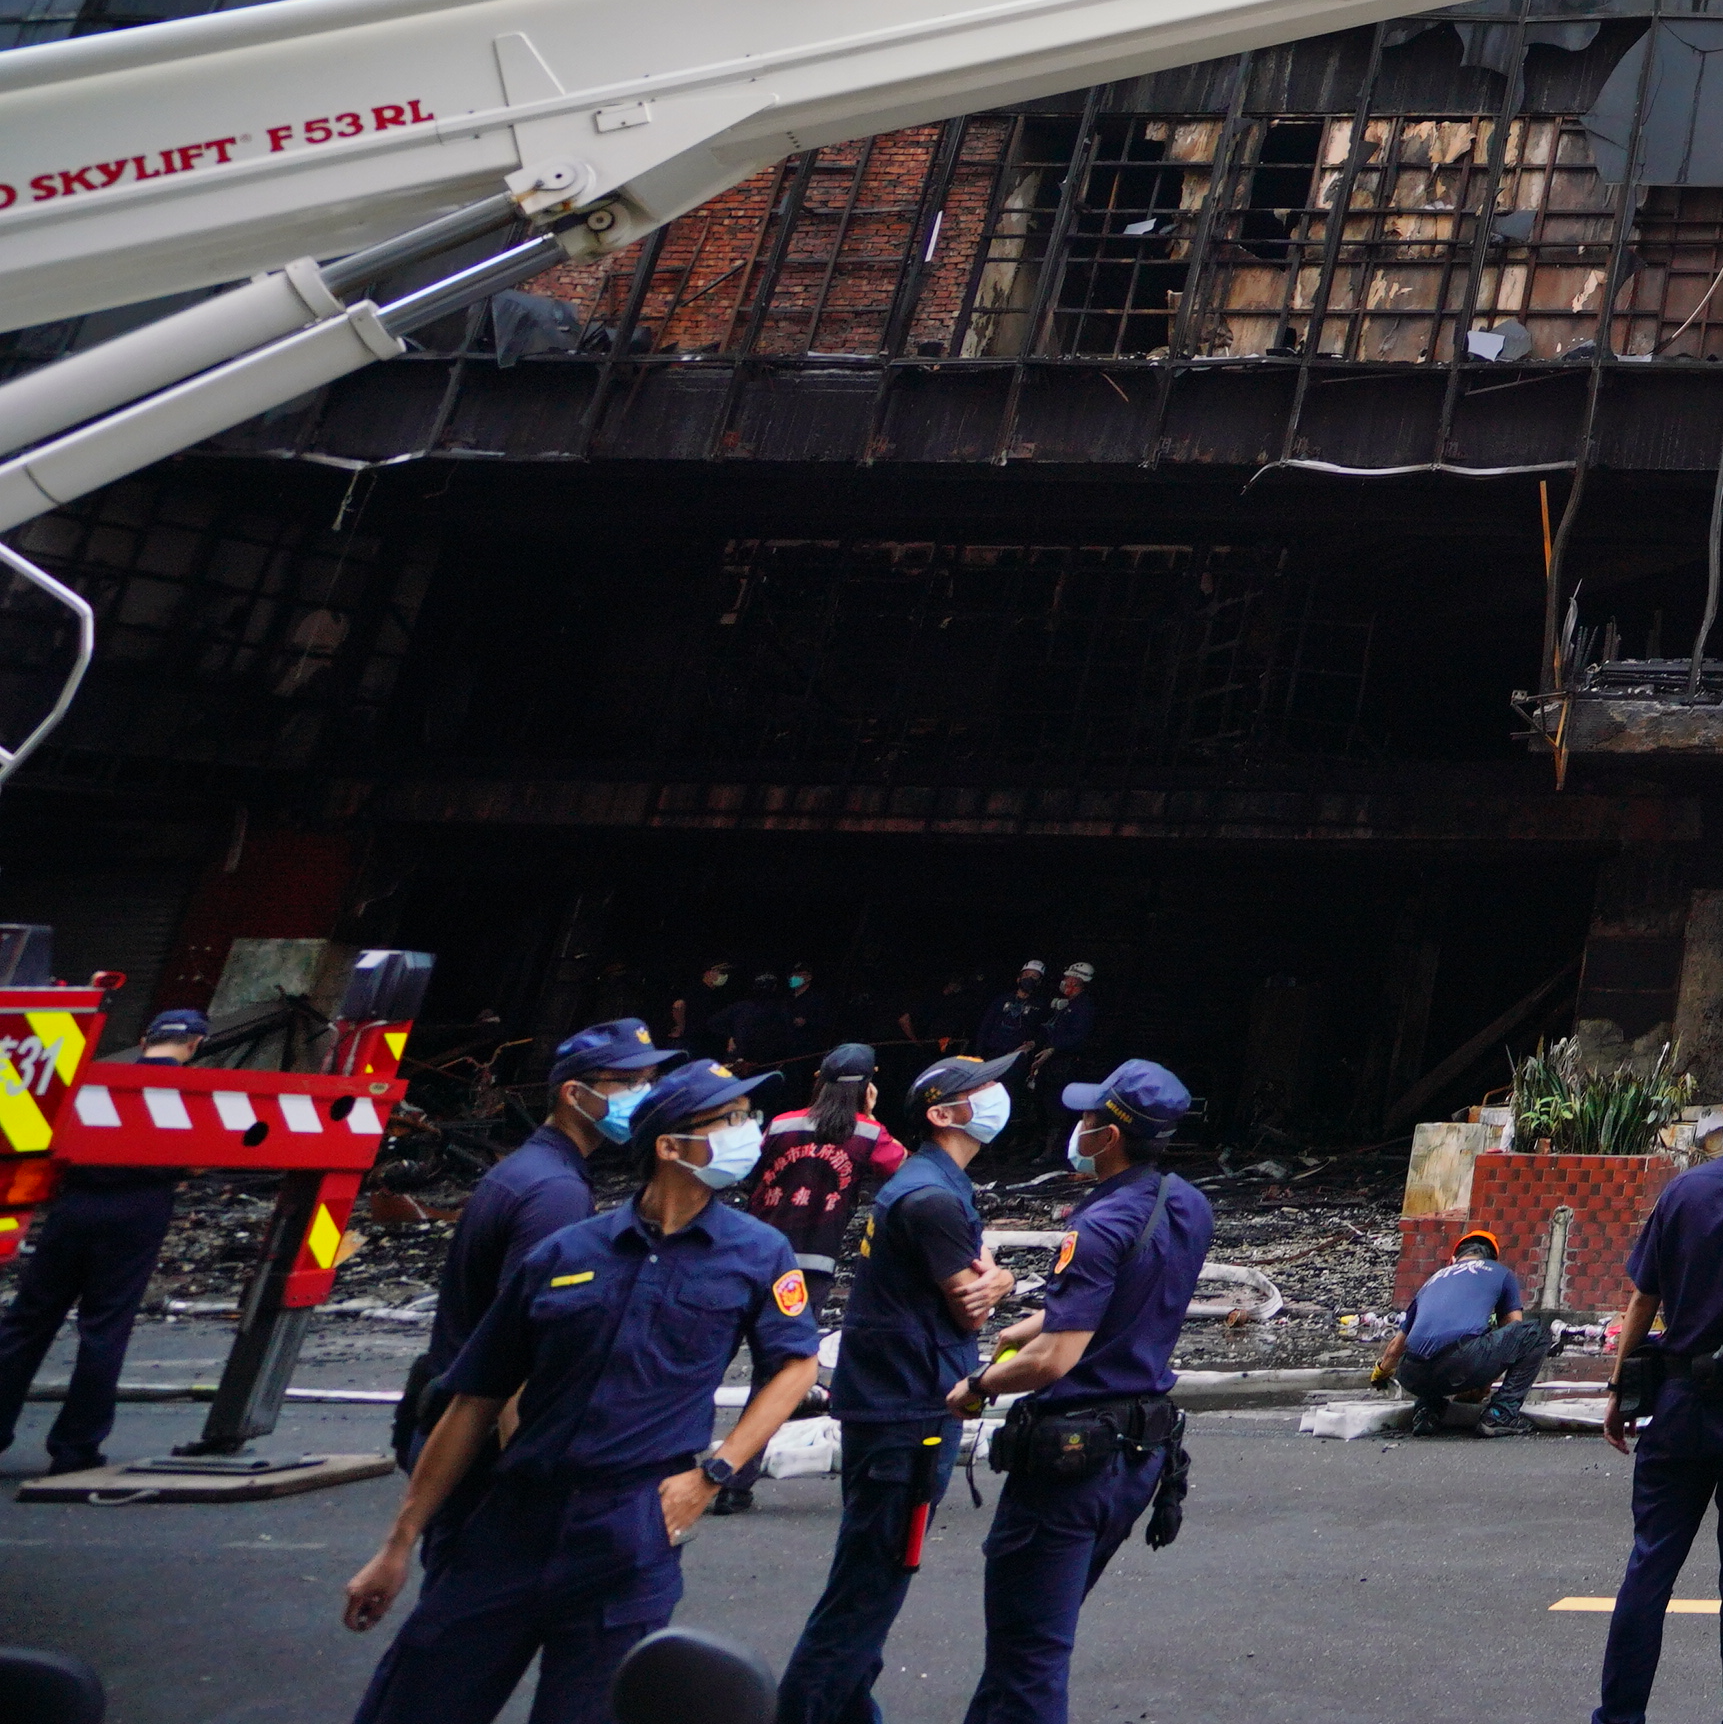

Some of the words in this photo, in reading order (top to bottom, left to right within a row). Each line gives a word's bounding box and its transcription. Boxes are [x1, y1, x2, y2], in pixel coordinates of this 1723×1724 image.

[267, 125, 293, 152] F
[304, 112, 364, 144] 53
[371, 100, 434, 132] RL
